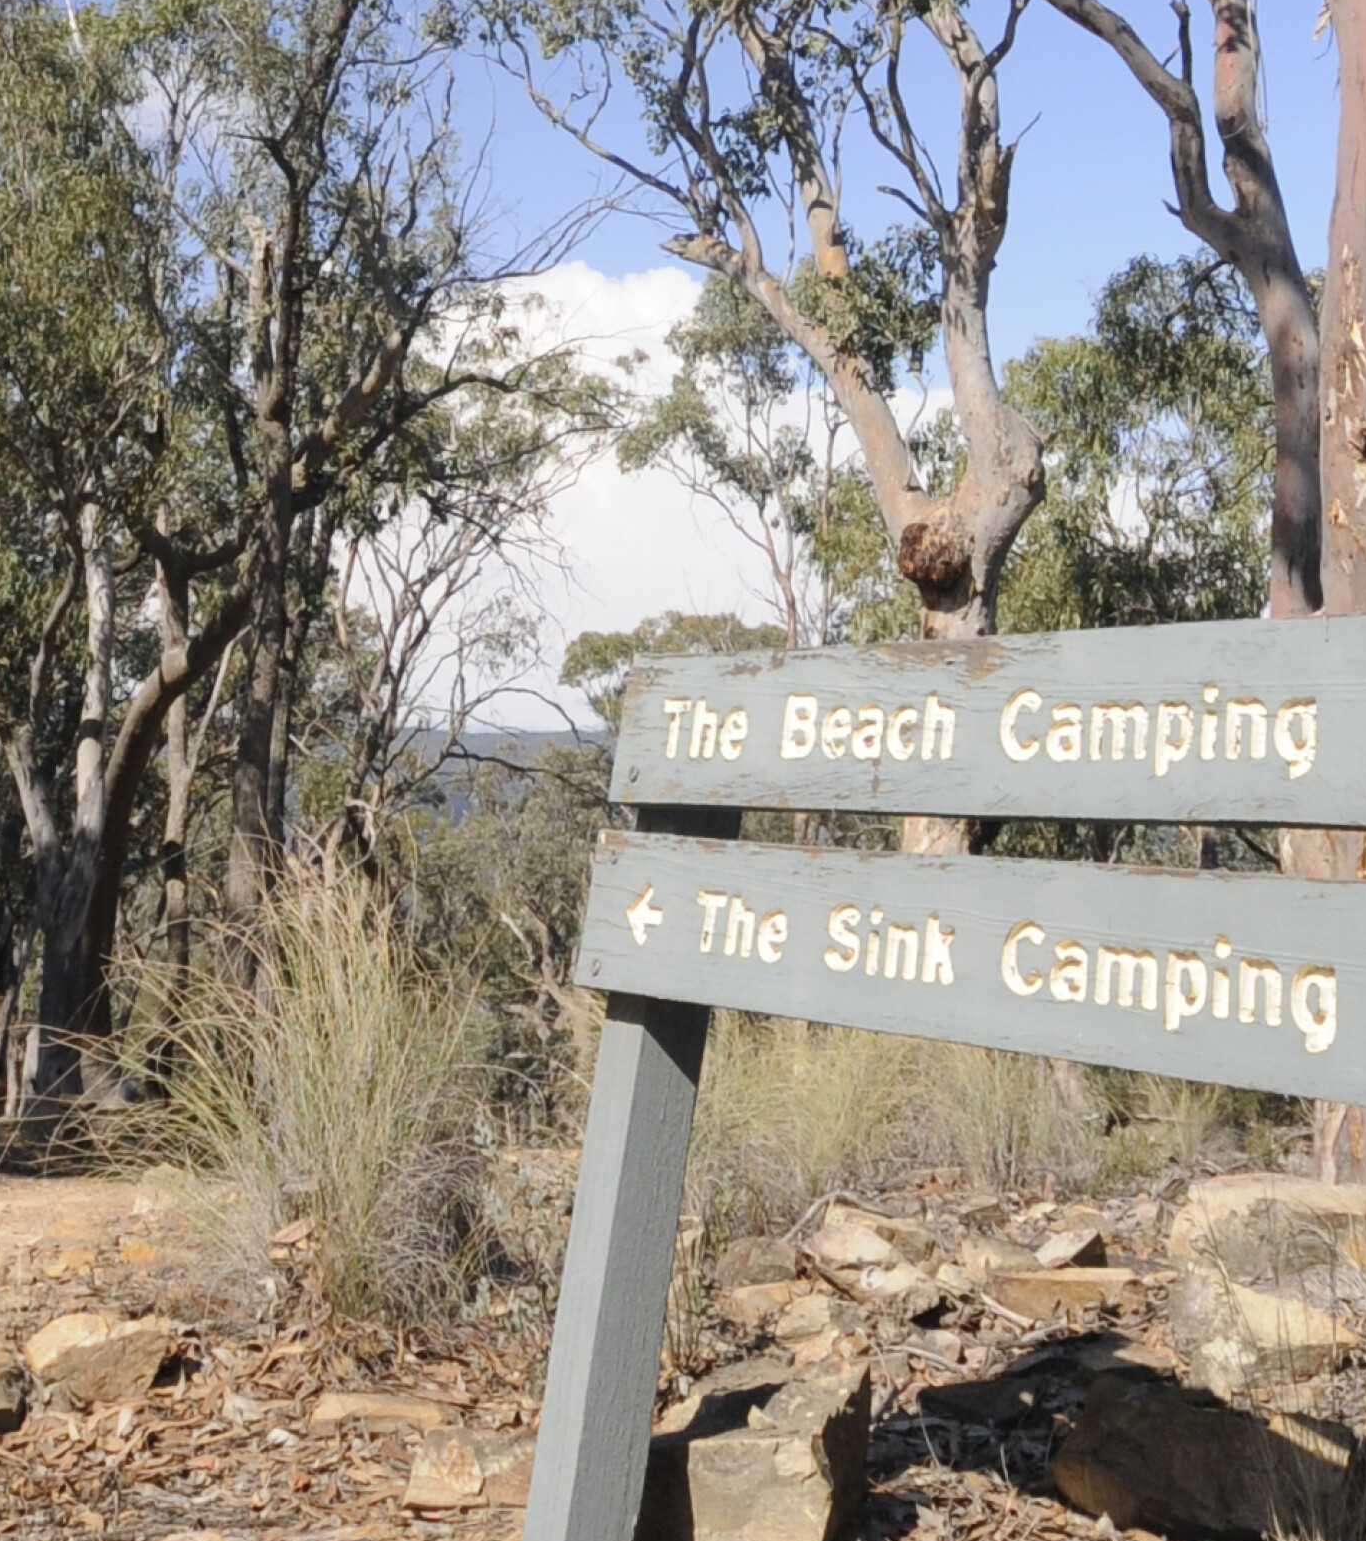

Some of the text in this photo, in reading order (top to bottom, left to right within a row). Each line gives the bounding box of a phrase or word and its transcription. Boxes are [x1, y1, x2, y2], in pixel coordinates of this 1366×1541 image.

[662, 697, 748, 760] The
[780, 693, 954, 761] Beach
[1000, 685, 1318, 779] Camping
[696, 889, 788, 964] The
[823, 904, 956, 986] Sink
[1000, 919, 1337, 1054] Camping
